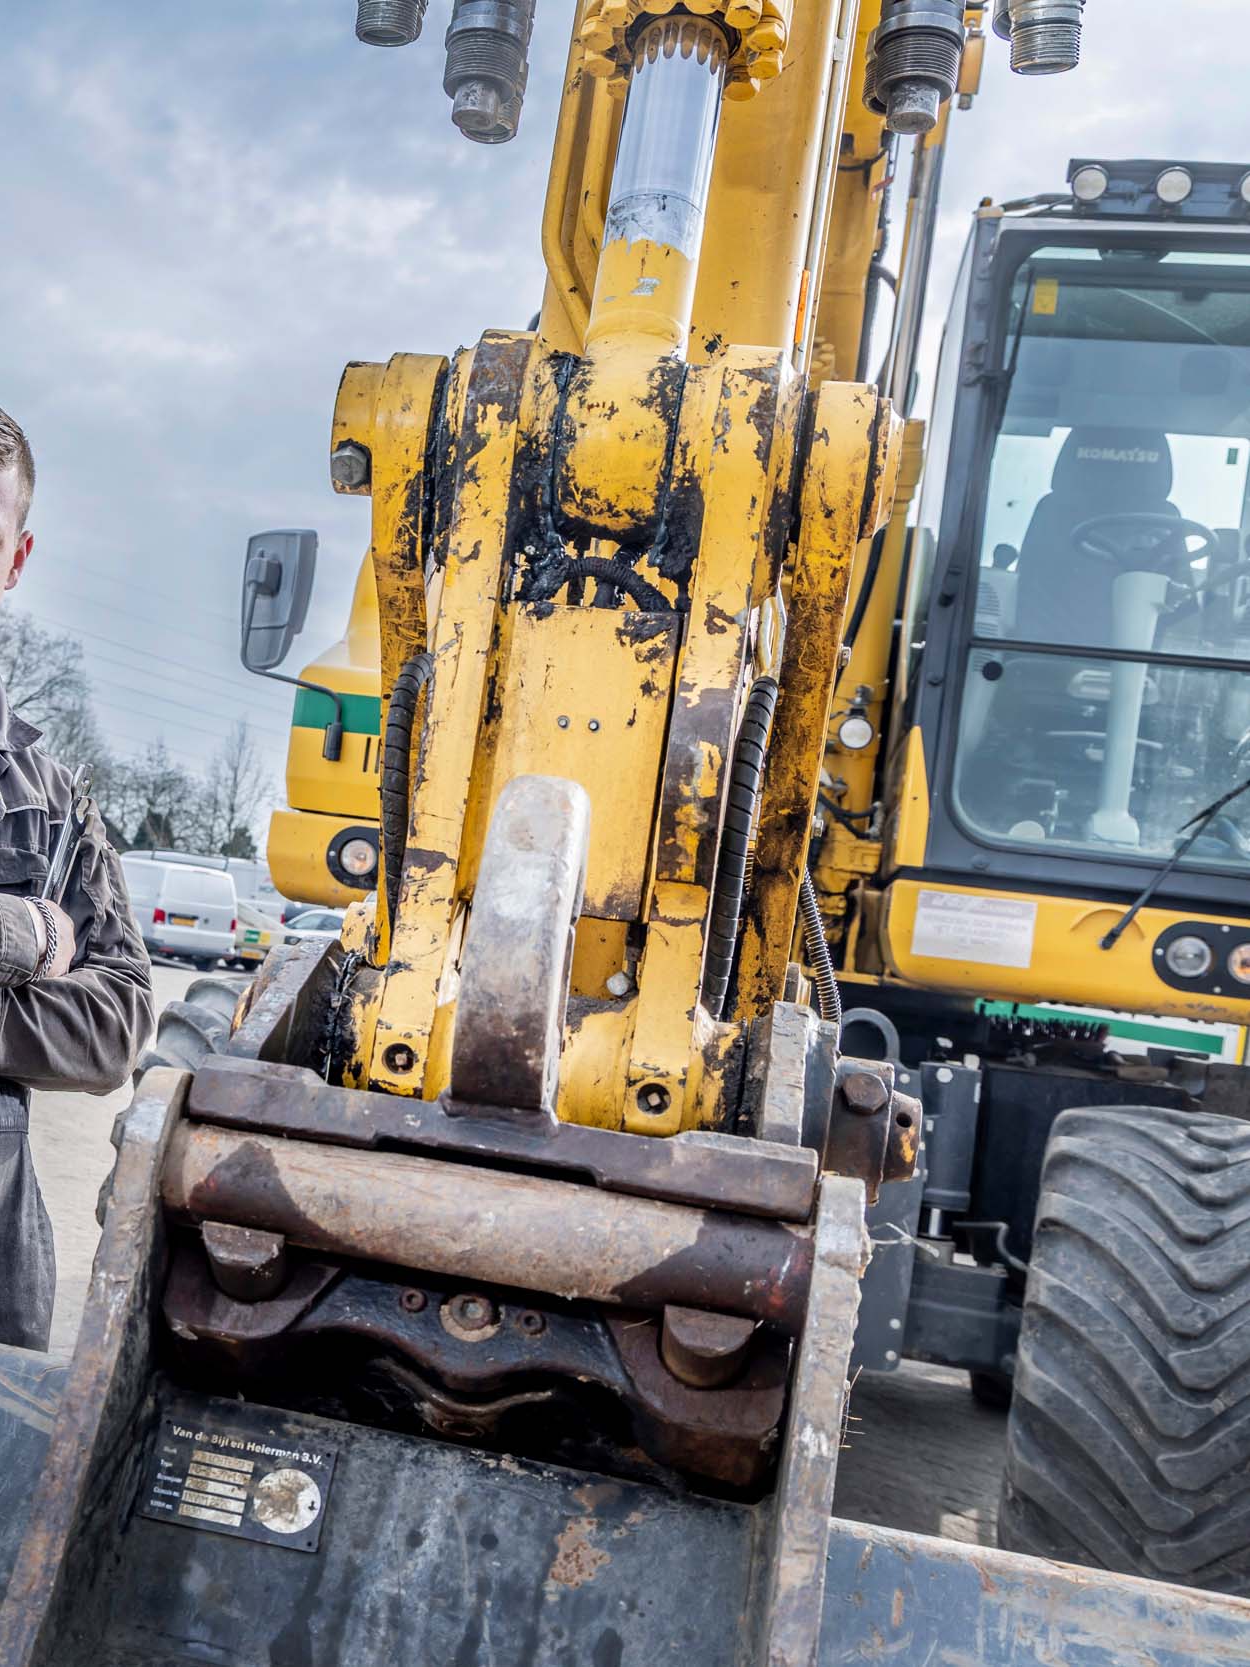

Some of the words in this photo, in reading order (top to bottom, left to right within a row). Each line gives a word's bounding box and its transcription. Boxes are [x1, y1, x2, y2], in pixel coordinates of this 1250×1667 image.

[173, 1425, 193, 1439] Van
[211, 1434, 230, 1448] Bijl
[230, 1440, 245, 1450] en
